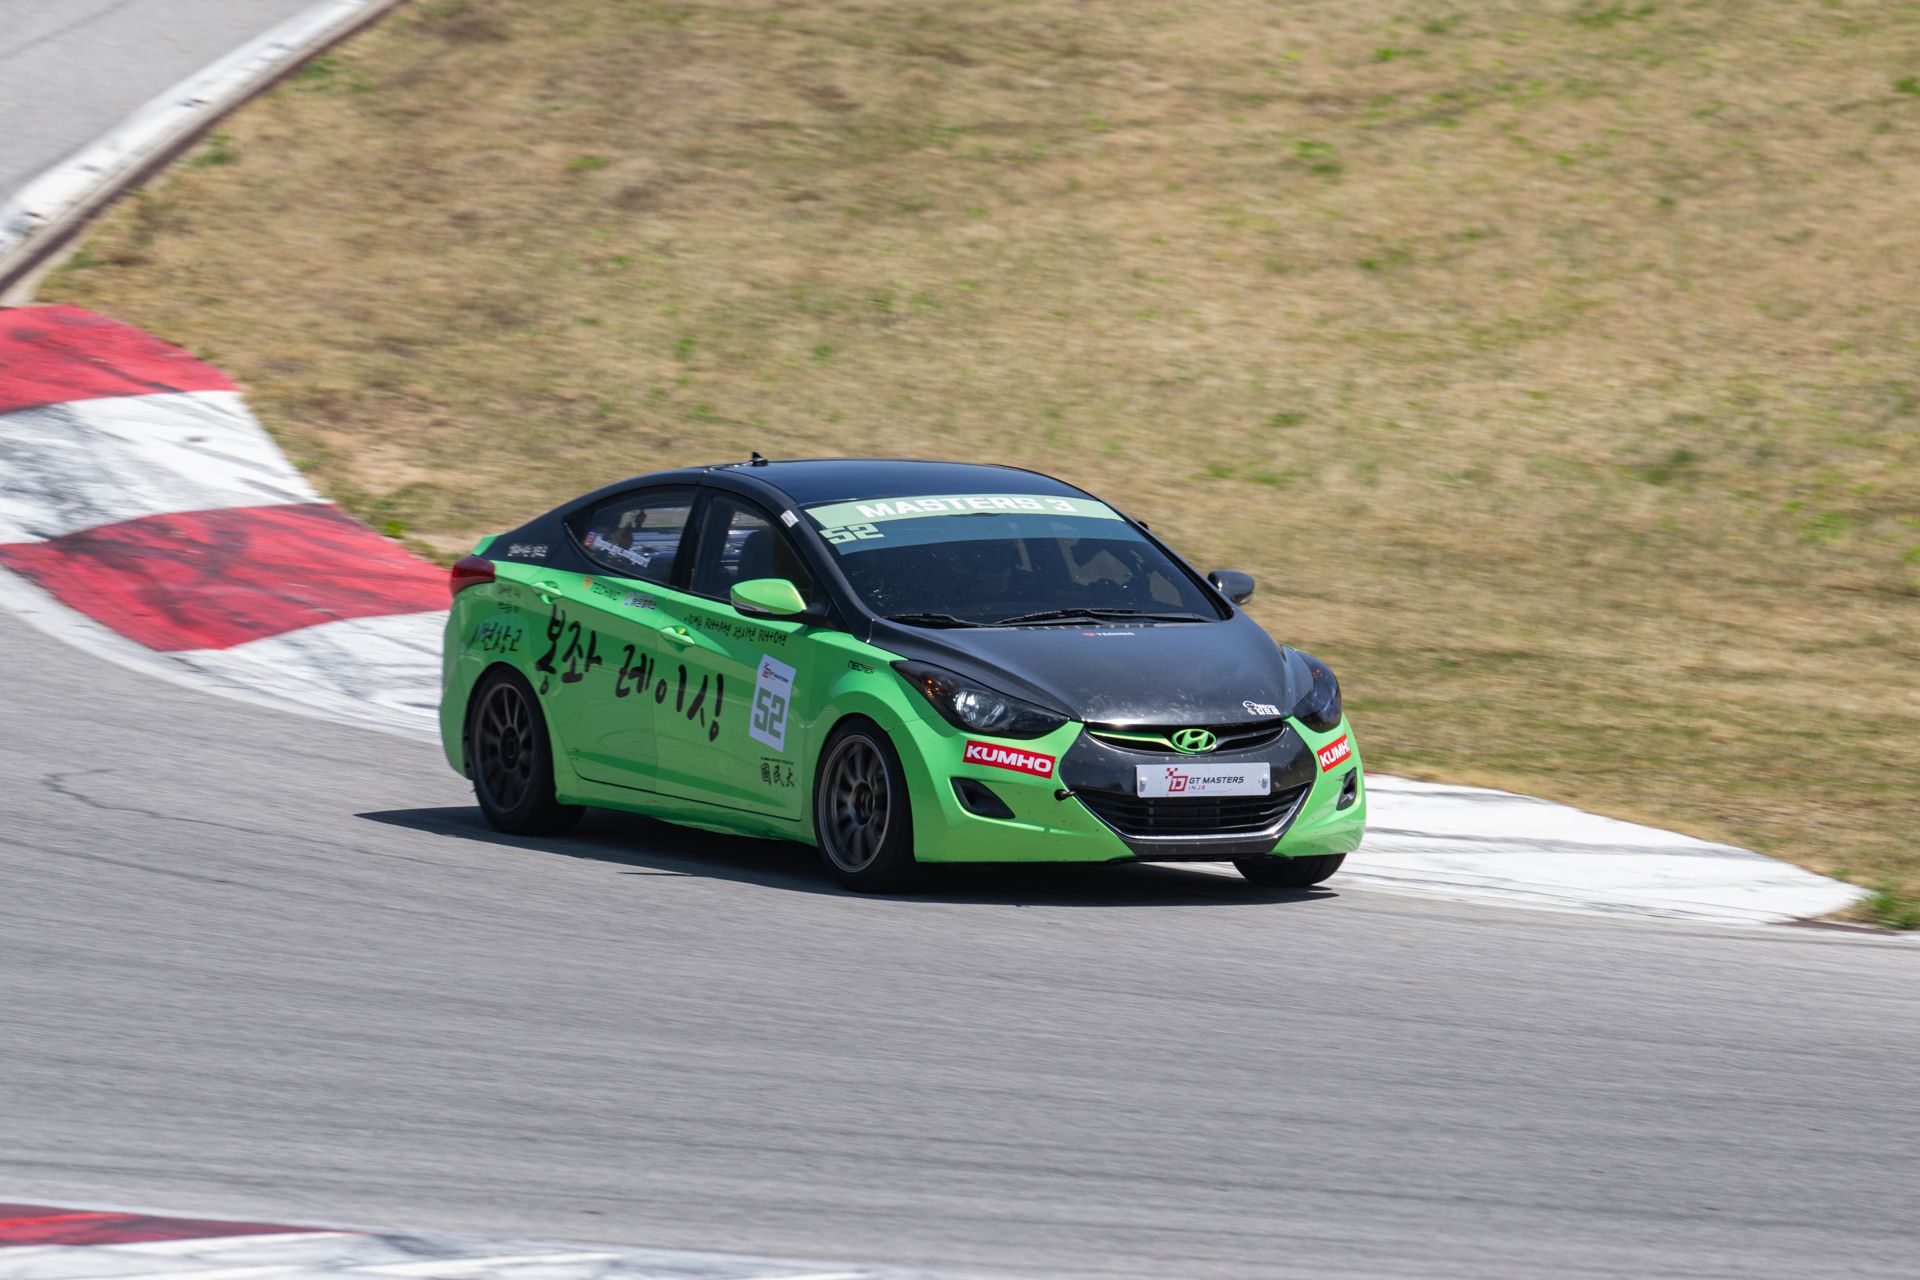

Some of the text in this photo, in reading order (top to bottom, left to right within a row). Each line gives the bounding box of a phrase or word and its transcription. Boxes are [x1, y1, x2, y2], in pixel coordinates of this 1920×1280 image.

[856, 497, 1078, 518] MASTERS 3
[819, 522, 885, 545] 52
[615, 643, 724, 743] 레이싱
[754, 686, 786, 740] 52
[966, 745, 1052, 773] KUMHO
[1320, 739, 1350, 768] KUMH
[1188, 776, 1244, 785] GT MASTERS
